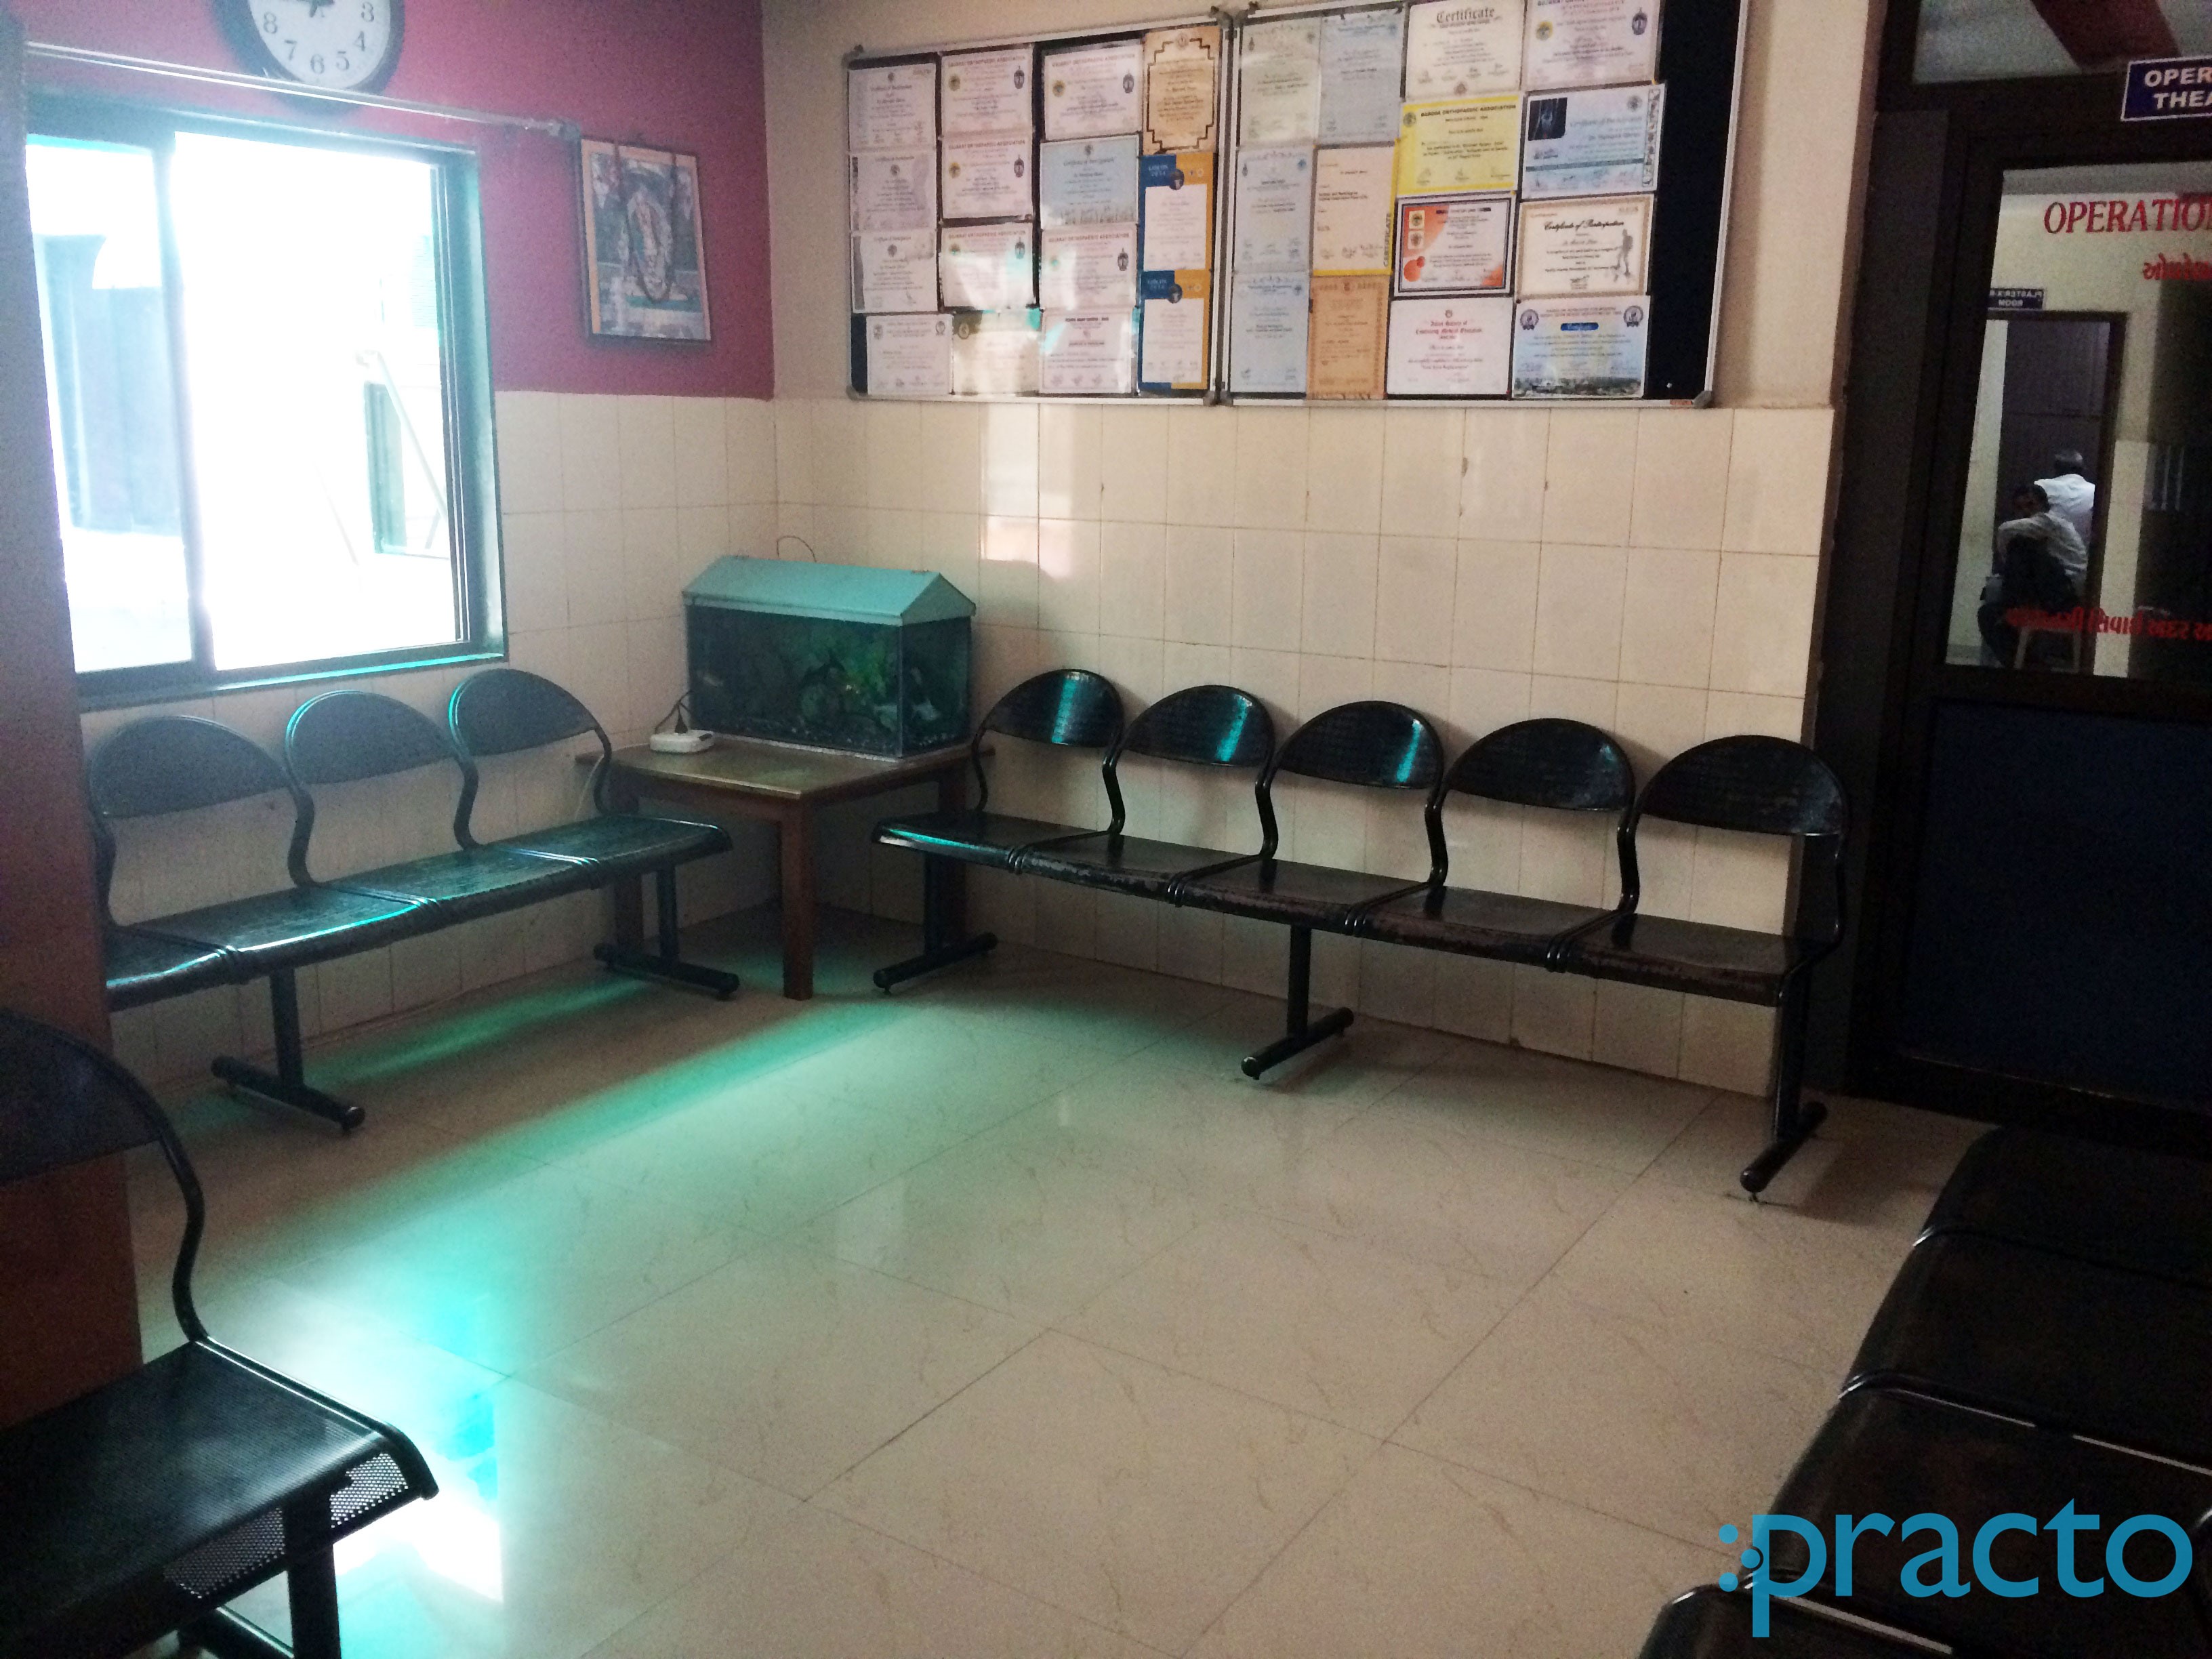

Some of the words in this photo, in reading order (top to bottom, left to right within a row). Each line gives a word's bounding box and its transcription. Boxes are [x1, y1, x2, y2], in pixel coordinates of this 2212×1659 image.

[361, 2, 374, 22] 3
[1436, 7, 1495, 23] Certificate
[263, 12, 278, 34] 8
[285, 39, 297, 60] 7
[354, 31, 366, 52] 4
[310, 54, 325, 74] 6
[336, 51, 350, 70] 5
[2043, 197, 2212, 234] OPERATIO
[1382, 213, 1392, 267] CERTIFICATE
